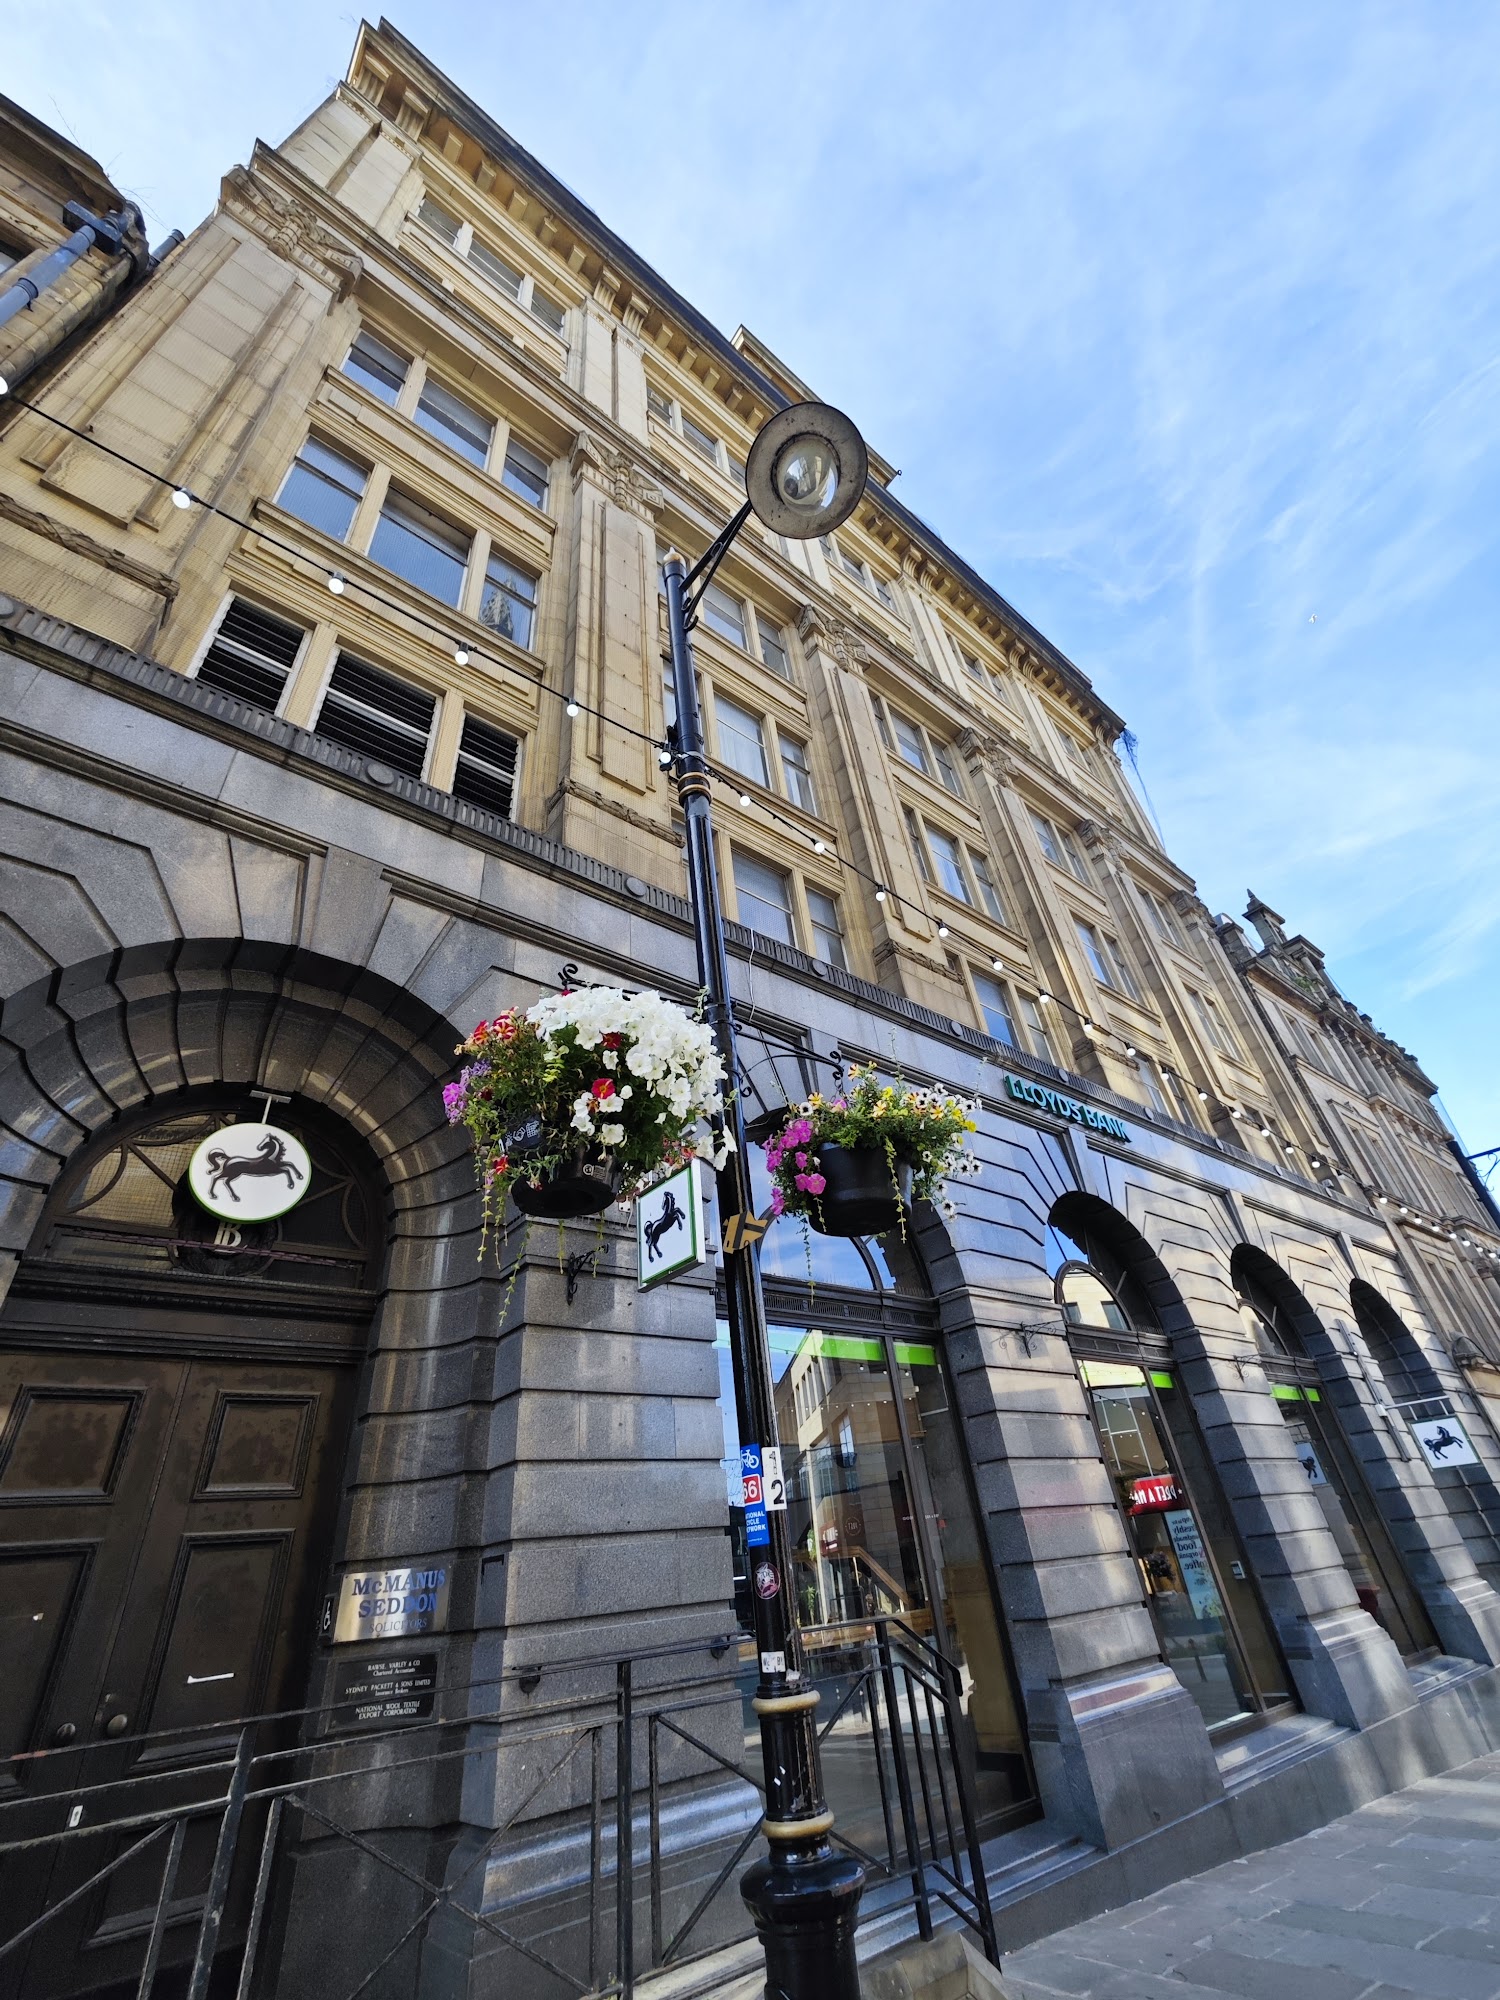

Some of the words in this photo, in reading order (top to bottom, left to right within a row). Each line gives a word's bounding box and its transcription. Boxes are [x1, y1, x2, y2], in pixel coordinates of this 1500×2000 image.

[1004, 1074, 1082, 1123] LLOYDS
[1082, 1105, 1131, 1143] BANK
[771, 1478, 785, 1505] 2
[351, 1568, 446, 1596] McMANUS
[358, 1592, 438, 1619] SEDDON
[371, 1618, 427, 1633] SOLICITORS
[345, 1686, 368, 1694] SYDNEY
[370, 1682, 393, 1691] PACKETT
[355, 1704, 383, 1714] NATIONAL
[358, 1710, 381, 1720] EXPORT
[383, 1708, 417, 1716] CORPORATION
